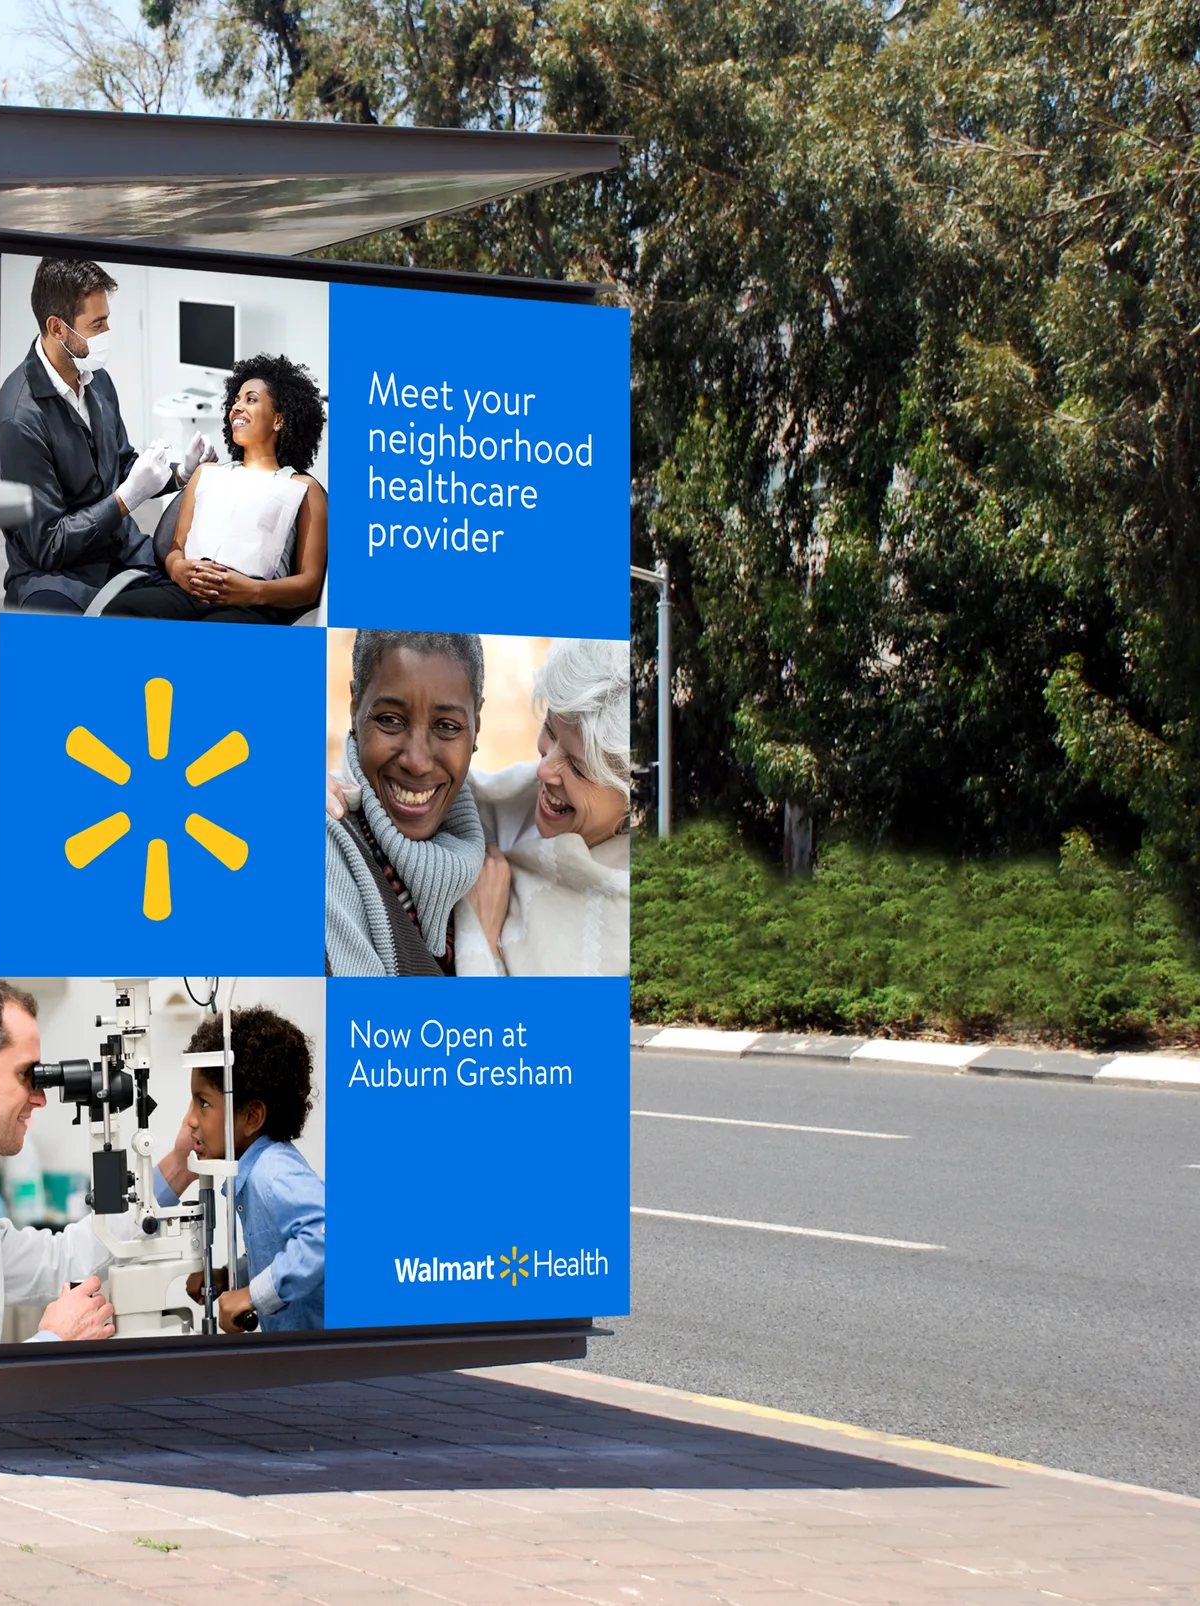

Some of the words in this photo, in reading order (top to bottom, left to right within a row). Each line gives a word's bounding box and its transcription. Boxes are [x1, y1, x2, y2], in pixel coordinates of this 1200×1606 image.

[368, 371, 454, 411] Meet
[463, 389, 536, 423] your
[369, 421, 593, 467] neighborhood
[369, 465, 538, 509] healthcare
[368, 517, 505, 557] provider
[351, 1019, 412, 1049] Now
[420, 1019, 493, 1057] Open
[502, 1022, 528, 1048] at
[348, 1058, 447, 1088] Auburn
[456, 1057, 572, 1087] Gresham
[394, 1255, 495, 1283] Walmart
[534, 1247, 609, 1278] Health
